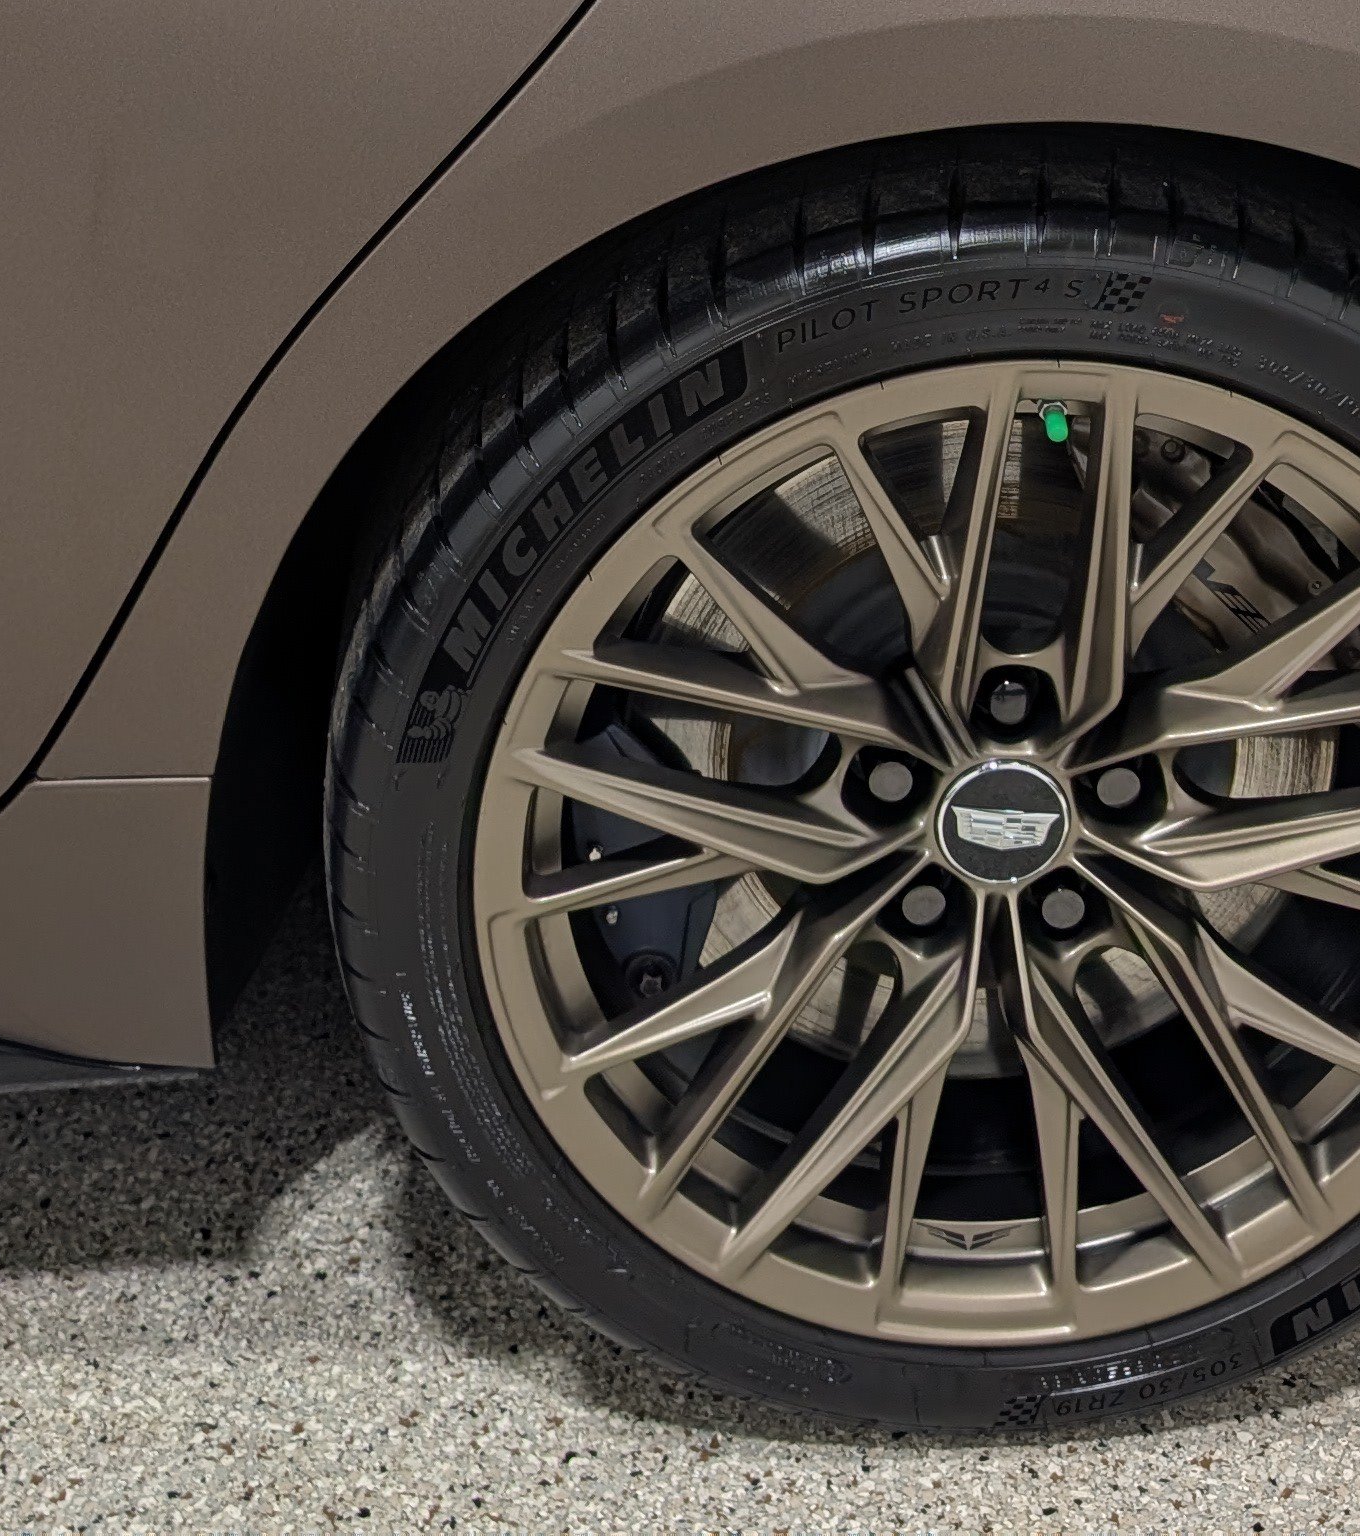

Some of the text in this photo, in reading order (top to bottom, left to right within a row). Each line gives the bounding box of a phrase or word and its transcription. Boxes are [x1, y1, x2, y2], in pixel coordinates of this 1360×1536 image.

[777, 278, 1087, 353] PILOT SPORT 4 S
[442, 359, 727, 672] MICHELIN
[1056, 1392, 1125, 1419] ZR19
[1138, 1352, 1244, 1401] 305/30
